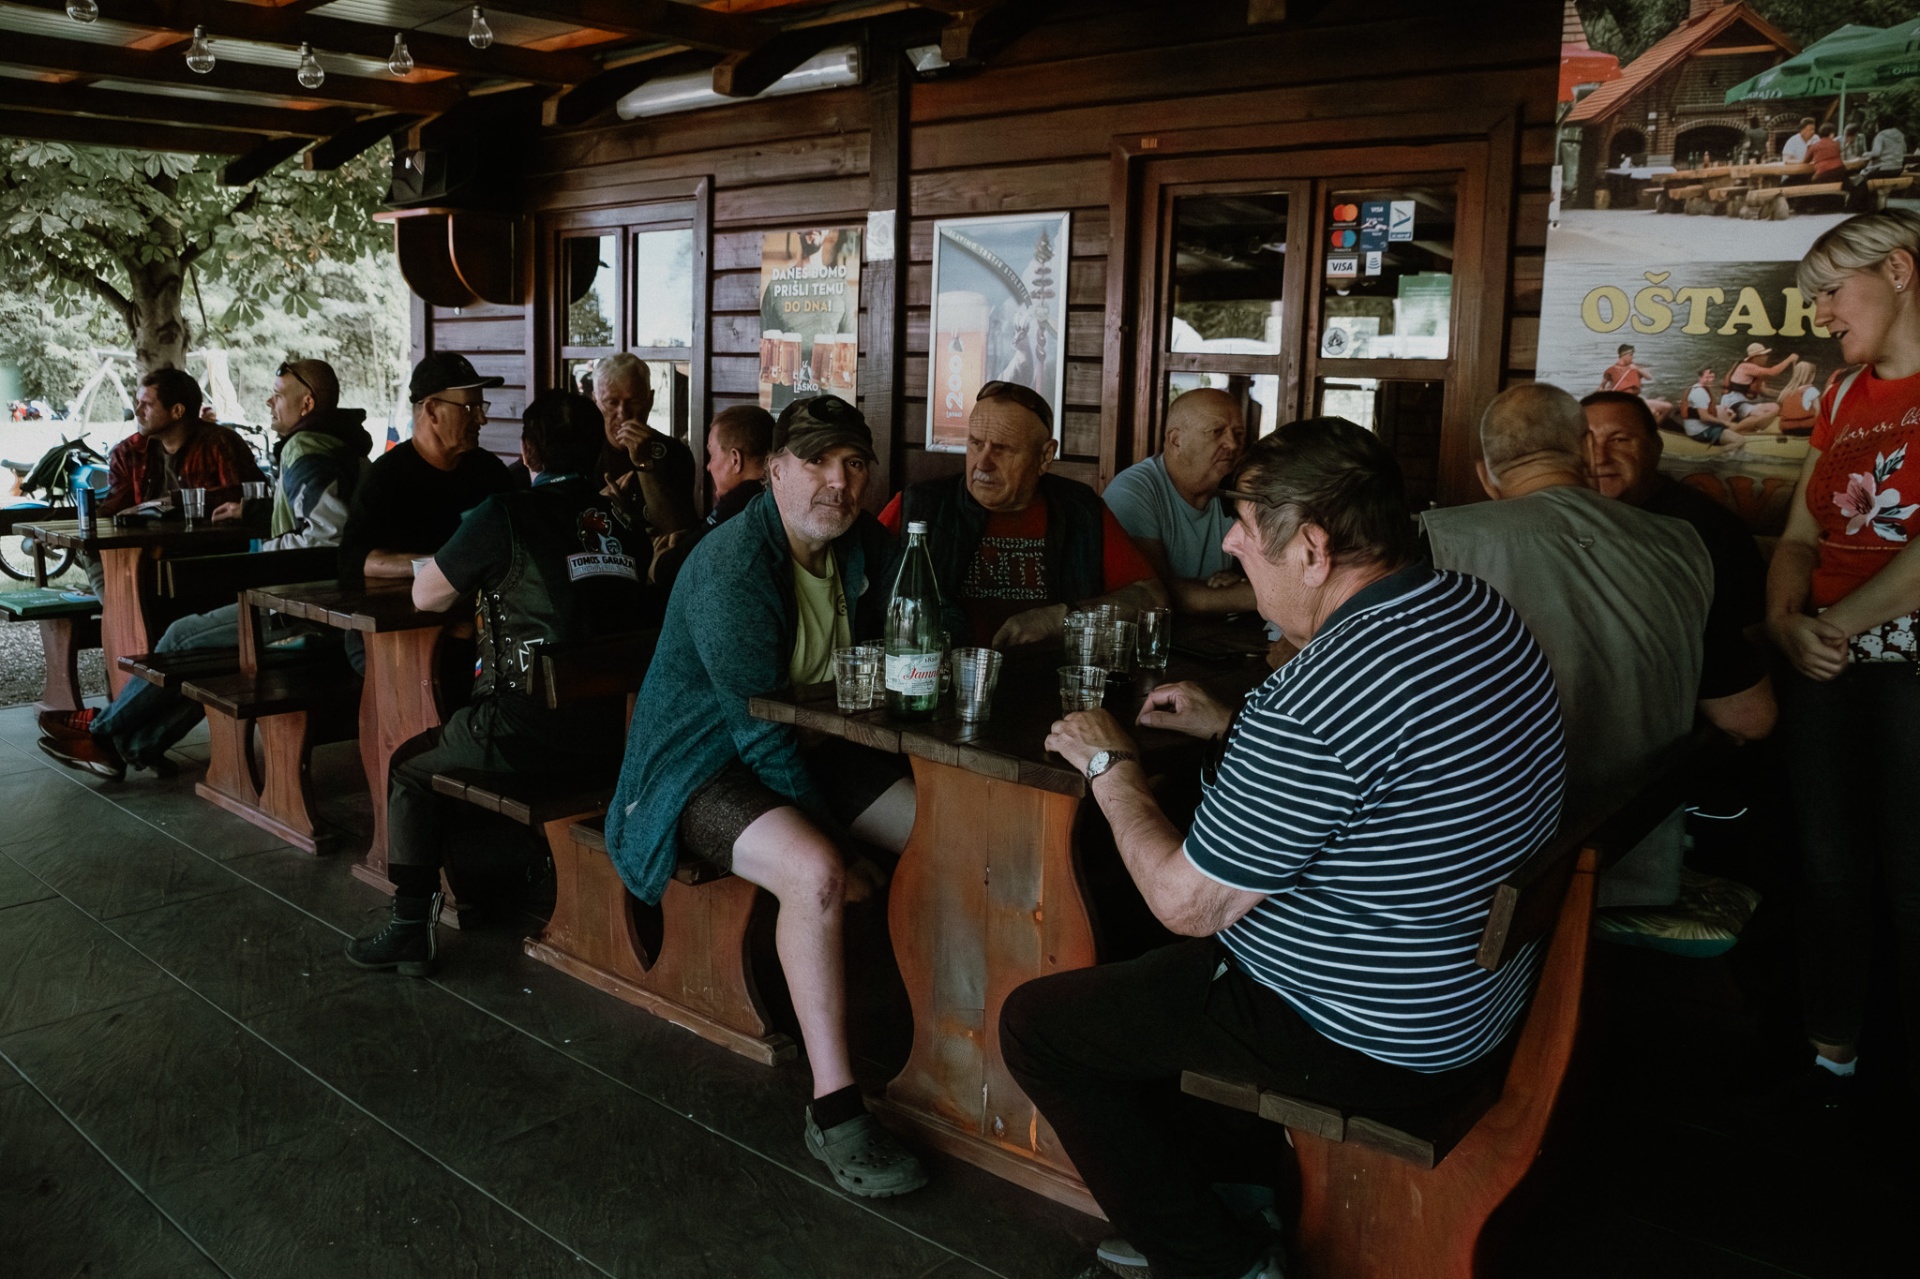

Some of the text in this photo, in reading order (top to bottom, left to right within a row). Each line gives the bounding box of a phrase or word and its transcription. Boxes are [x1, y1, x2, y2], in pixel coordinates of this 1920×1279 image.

[771, 264, 848, 280] DANES BOMO
[1331, 262, 1353, 271] VISA
[774, 280, 844, 297] PRIŠLI TEMU
[784, 300, 832, 313] DO DNA!
[571, 556, 600, 568] TOMOS
